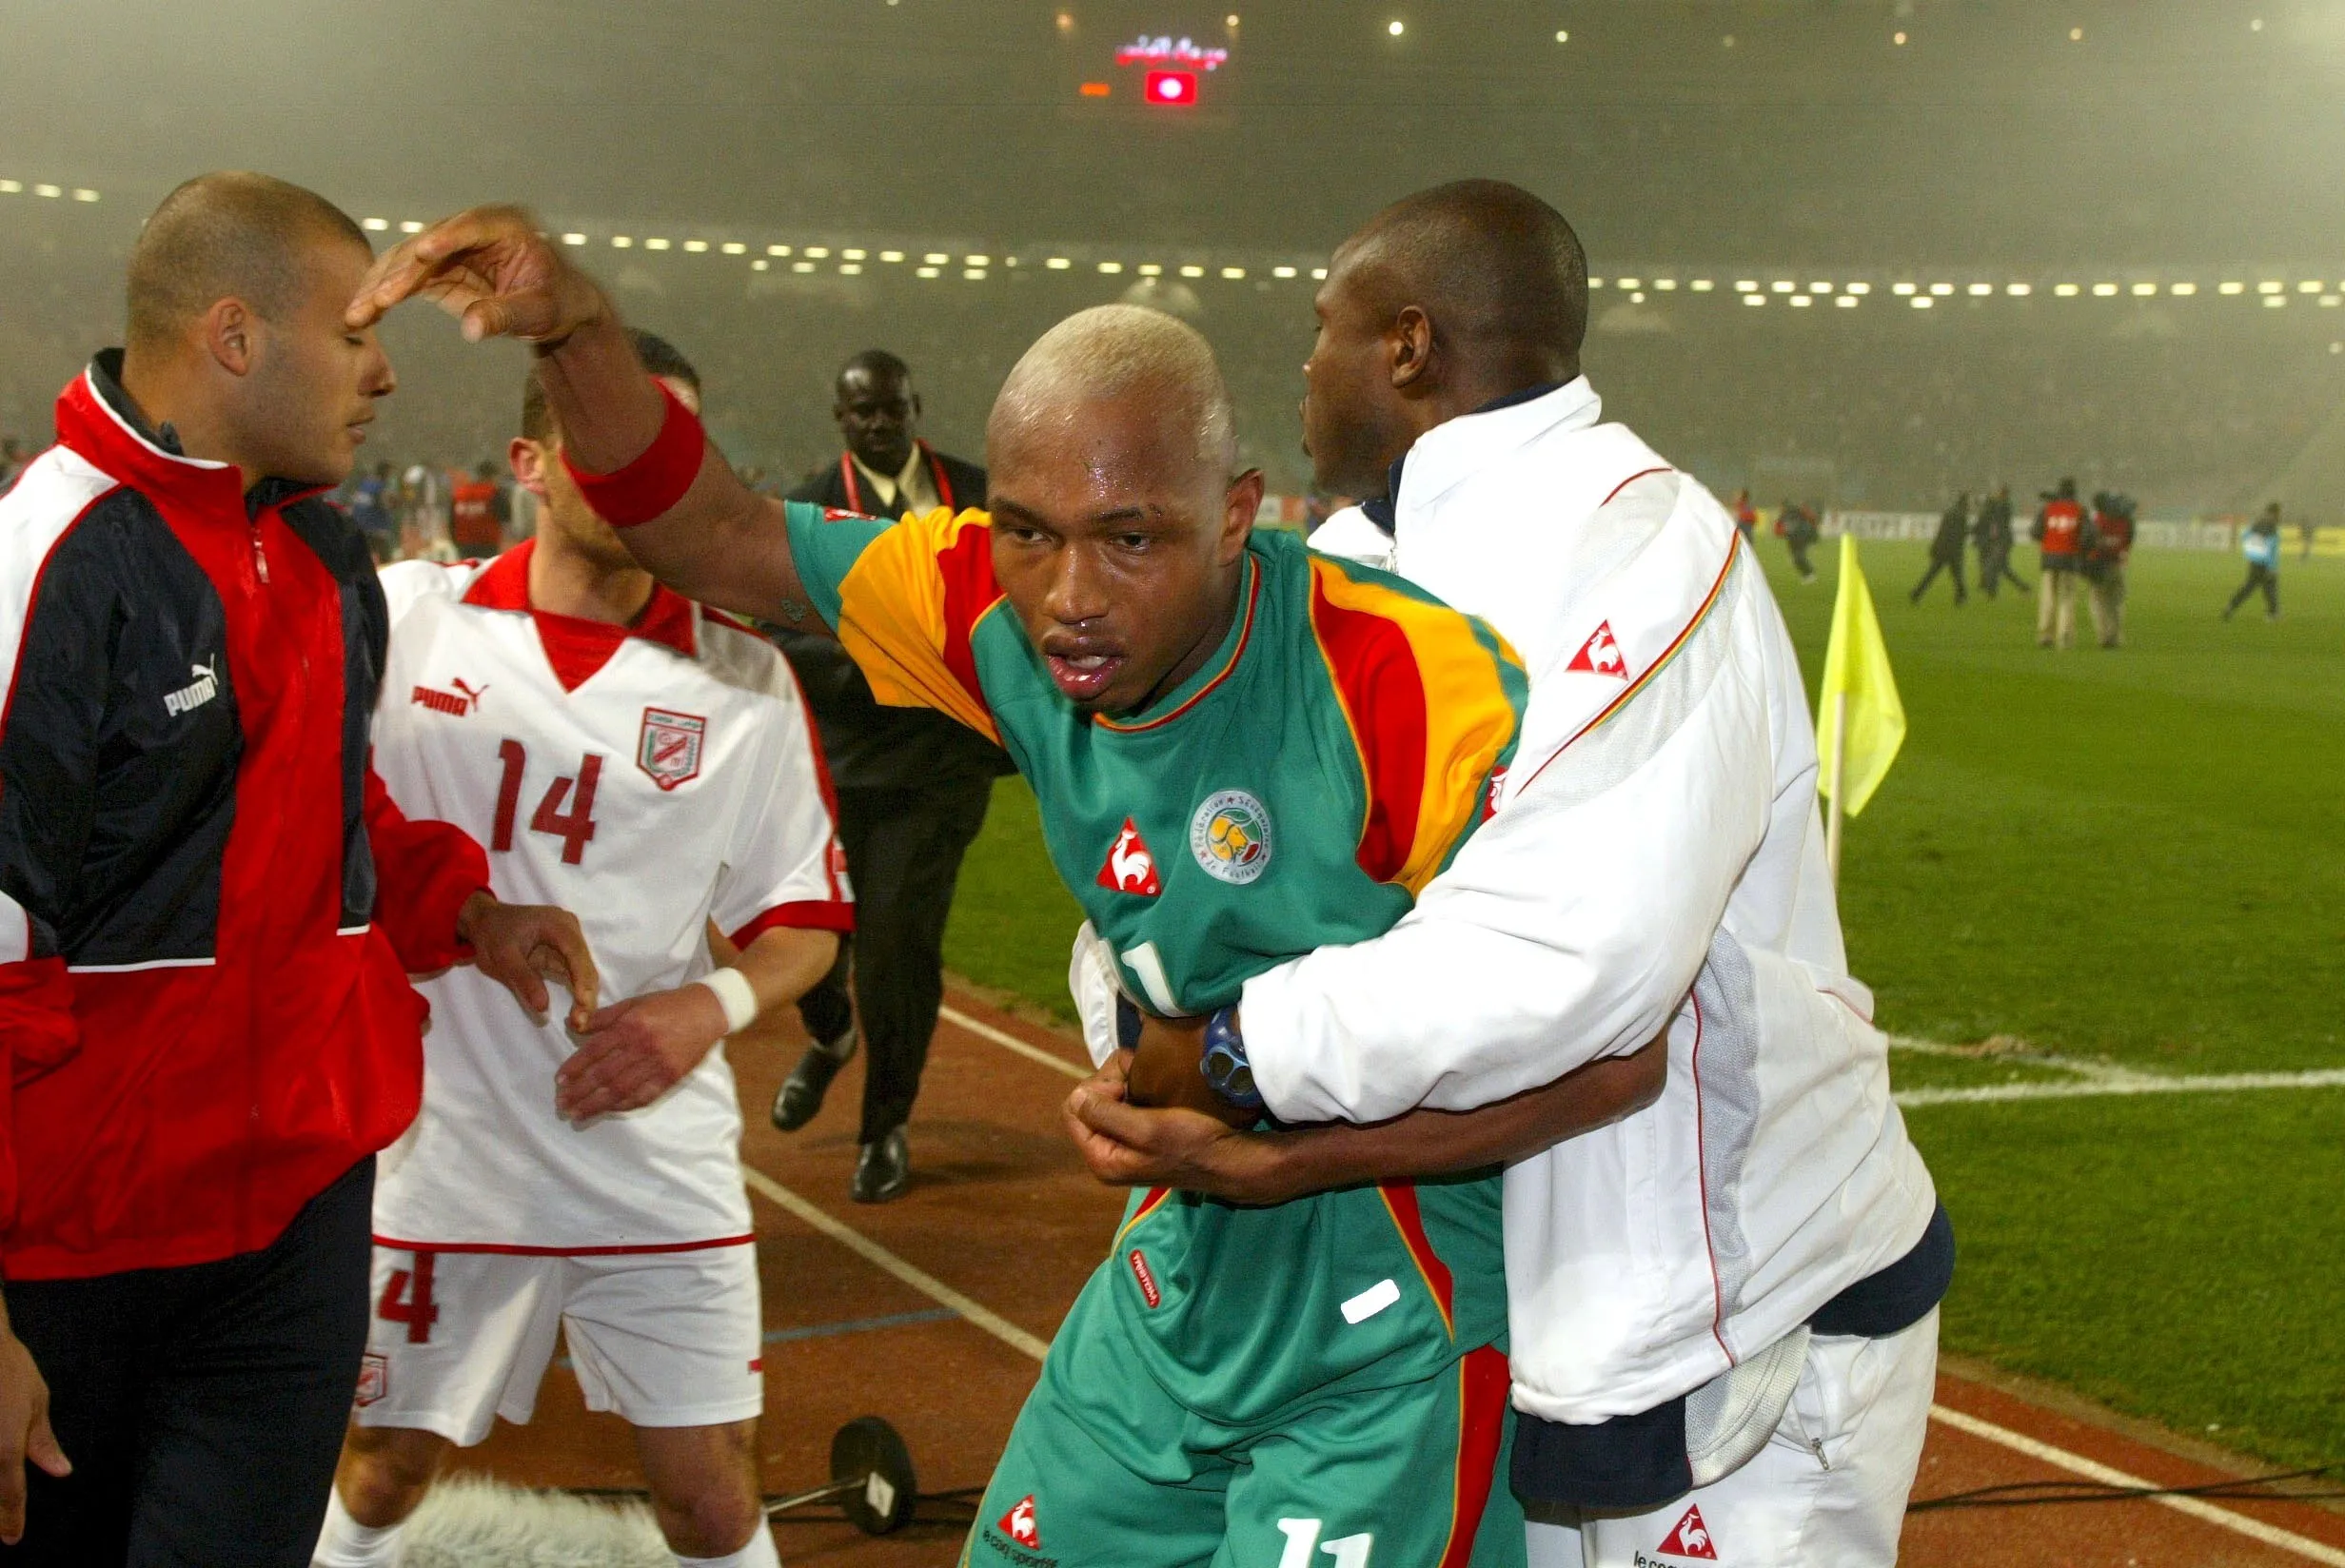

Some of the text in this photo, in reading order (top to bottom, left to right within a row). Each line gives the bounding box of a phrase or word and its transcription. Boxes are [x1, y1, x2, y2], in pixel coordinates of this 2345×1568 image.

[163, 676, 216, 717] PUMA
[410, 685, 468, 717] PUMA
[491, 738, 603, 865] 14
[1633, 1550, 1646, 1568] le
